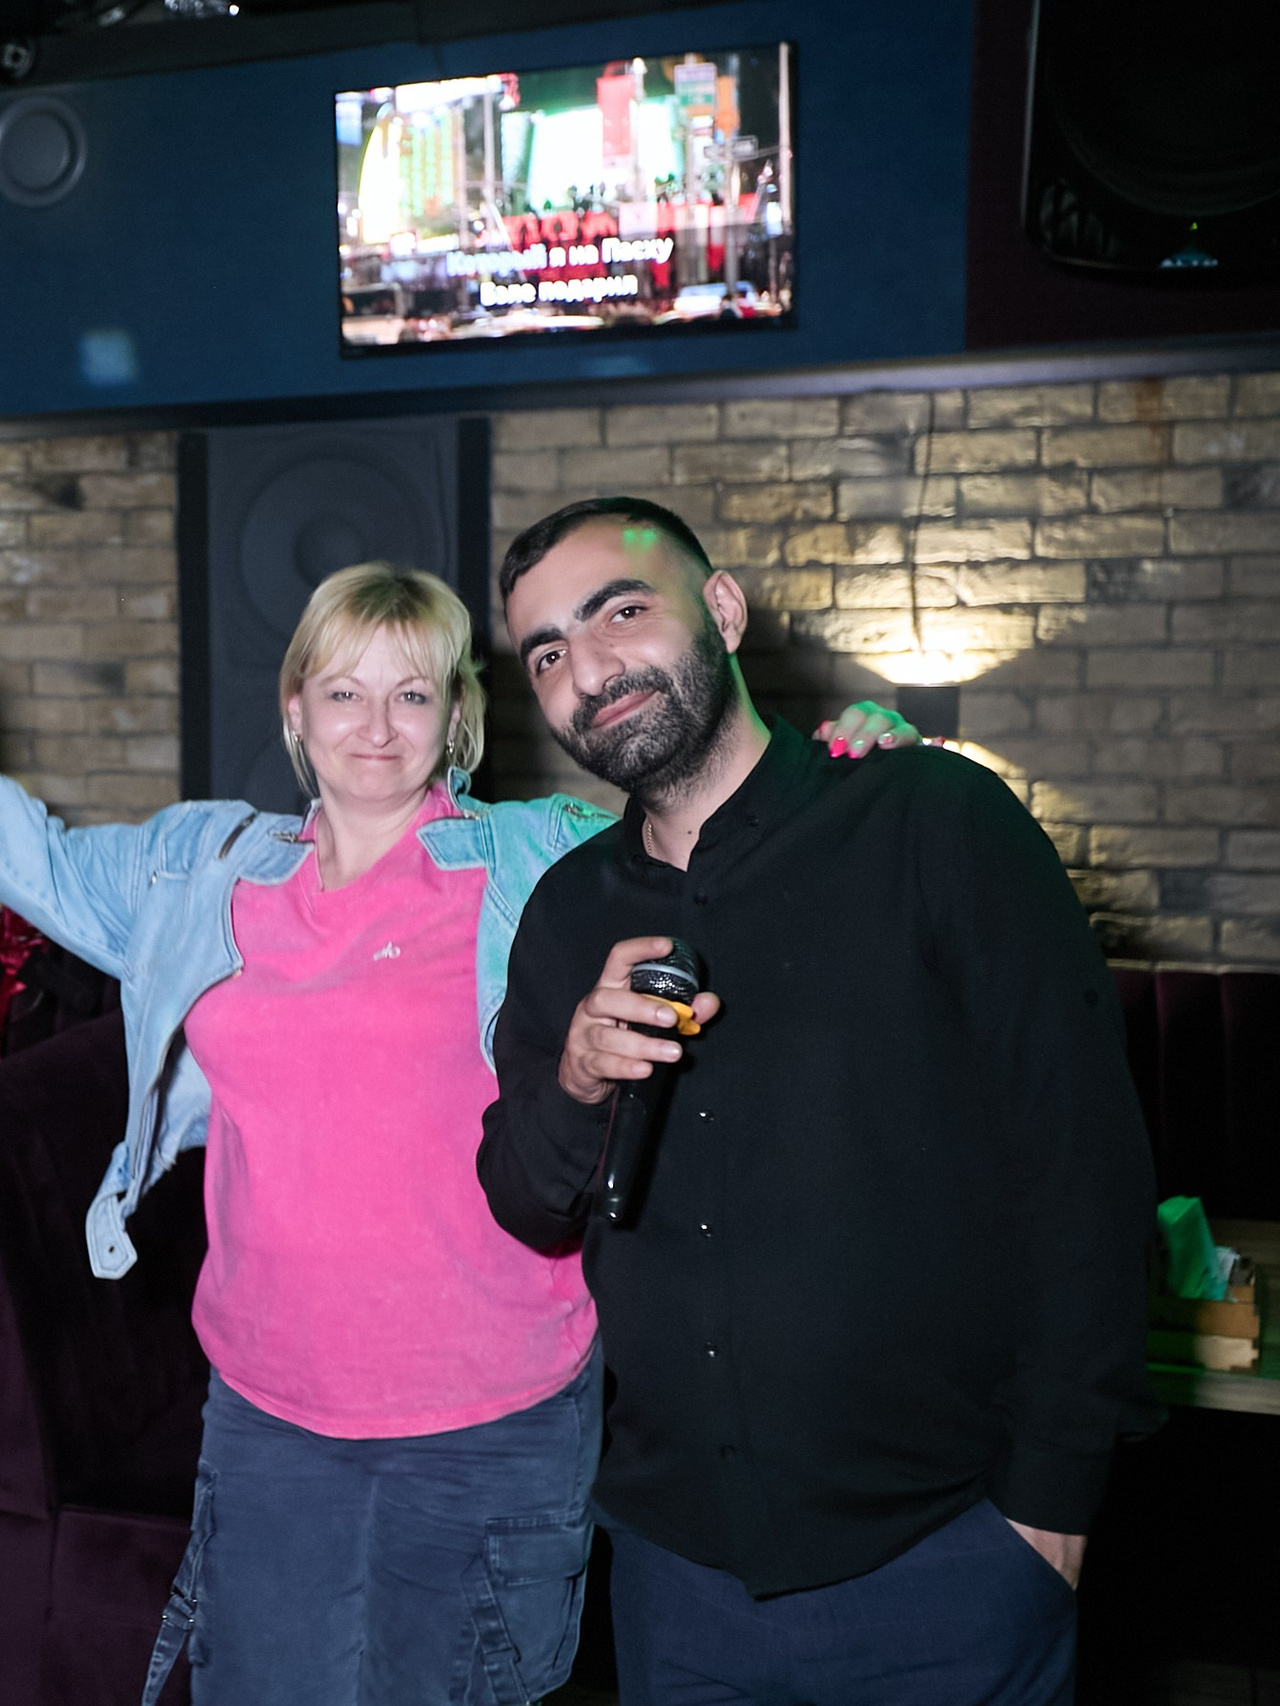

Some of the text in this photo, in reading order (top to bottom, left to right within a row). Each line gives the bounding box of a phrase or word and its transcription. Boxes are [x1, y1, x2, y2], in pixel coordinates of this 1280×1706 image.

[549, 247, 566, 267] я
[569, 244, 599, 266] на
[602, 237, 674, 264] Пасху
[538, 274, 638, 302] подарил
